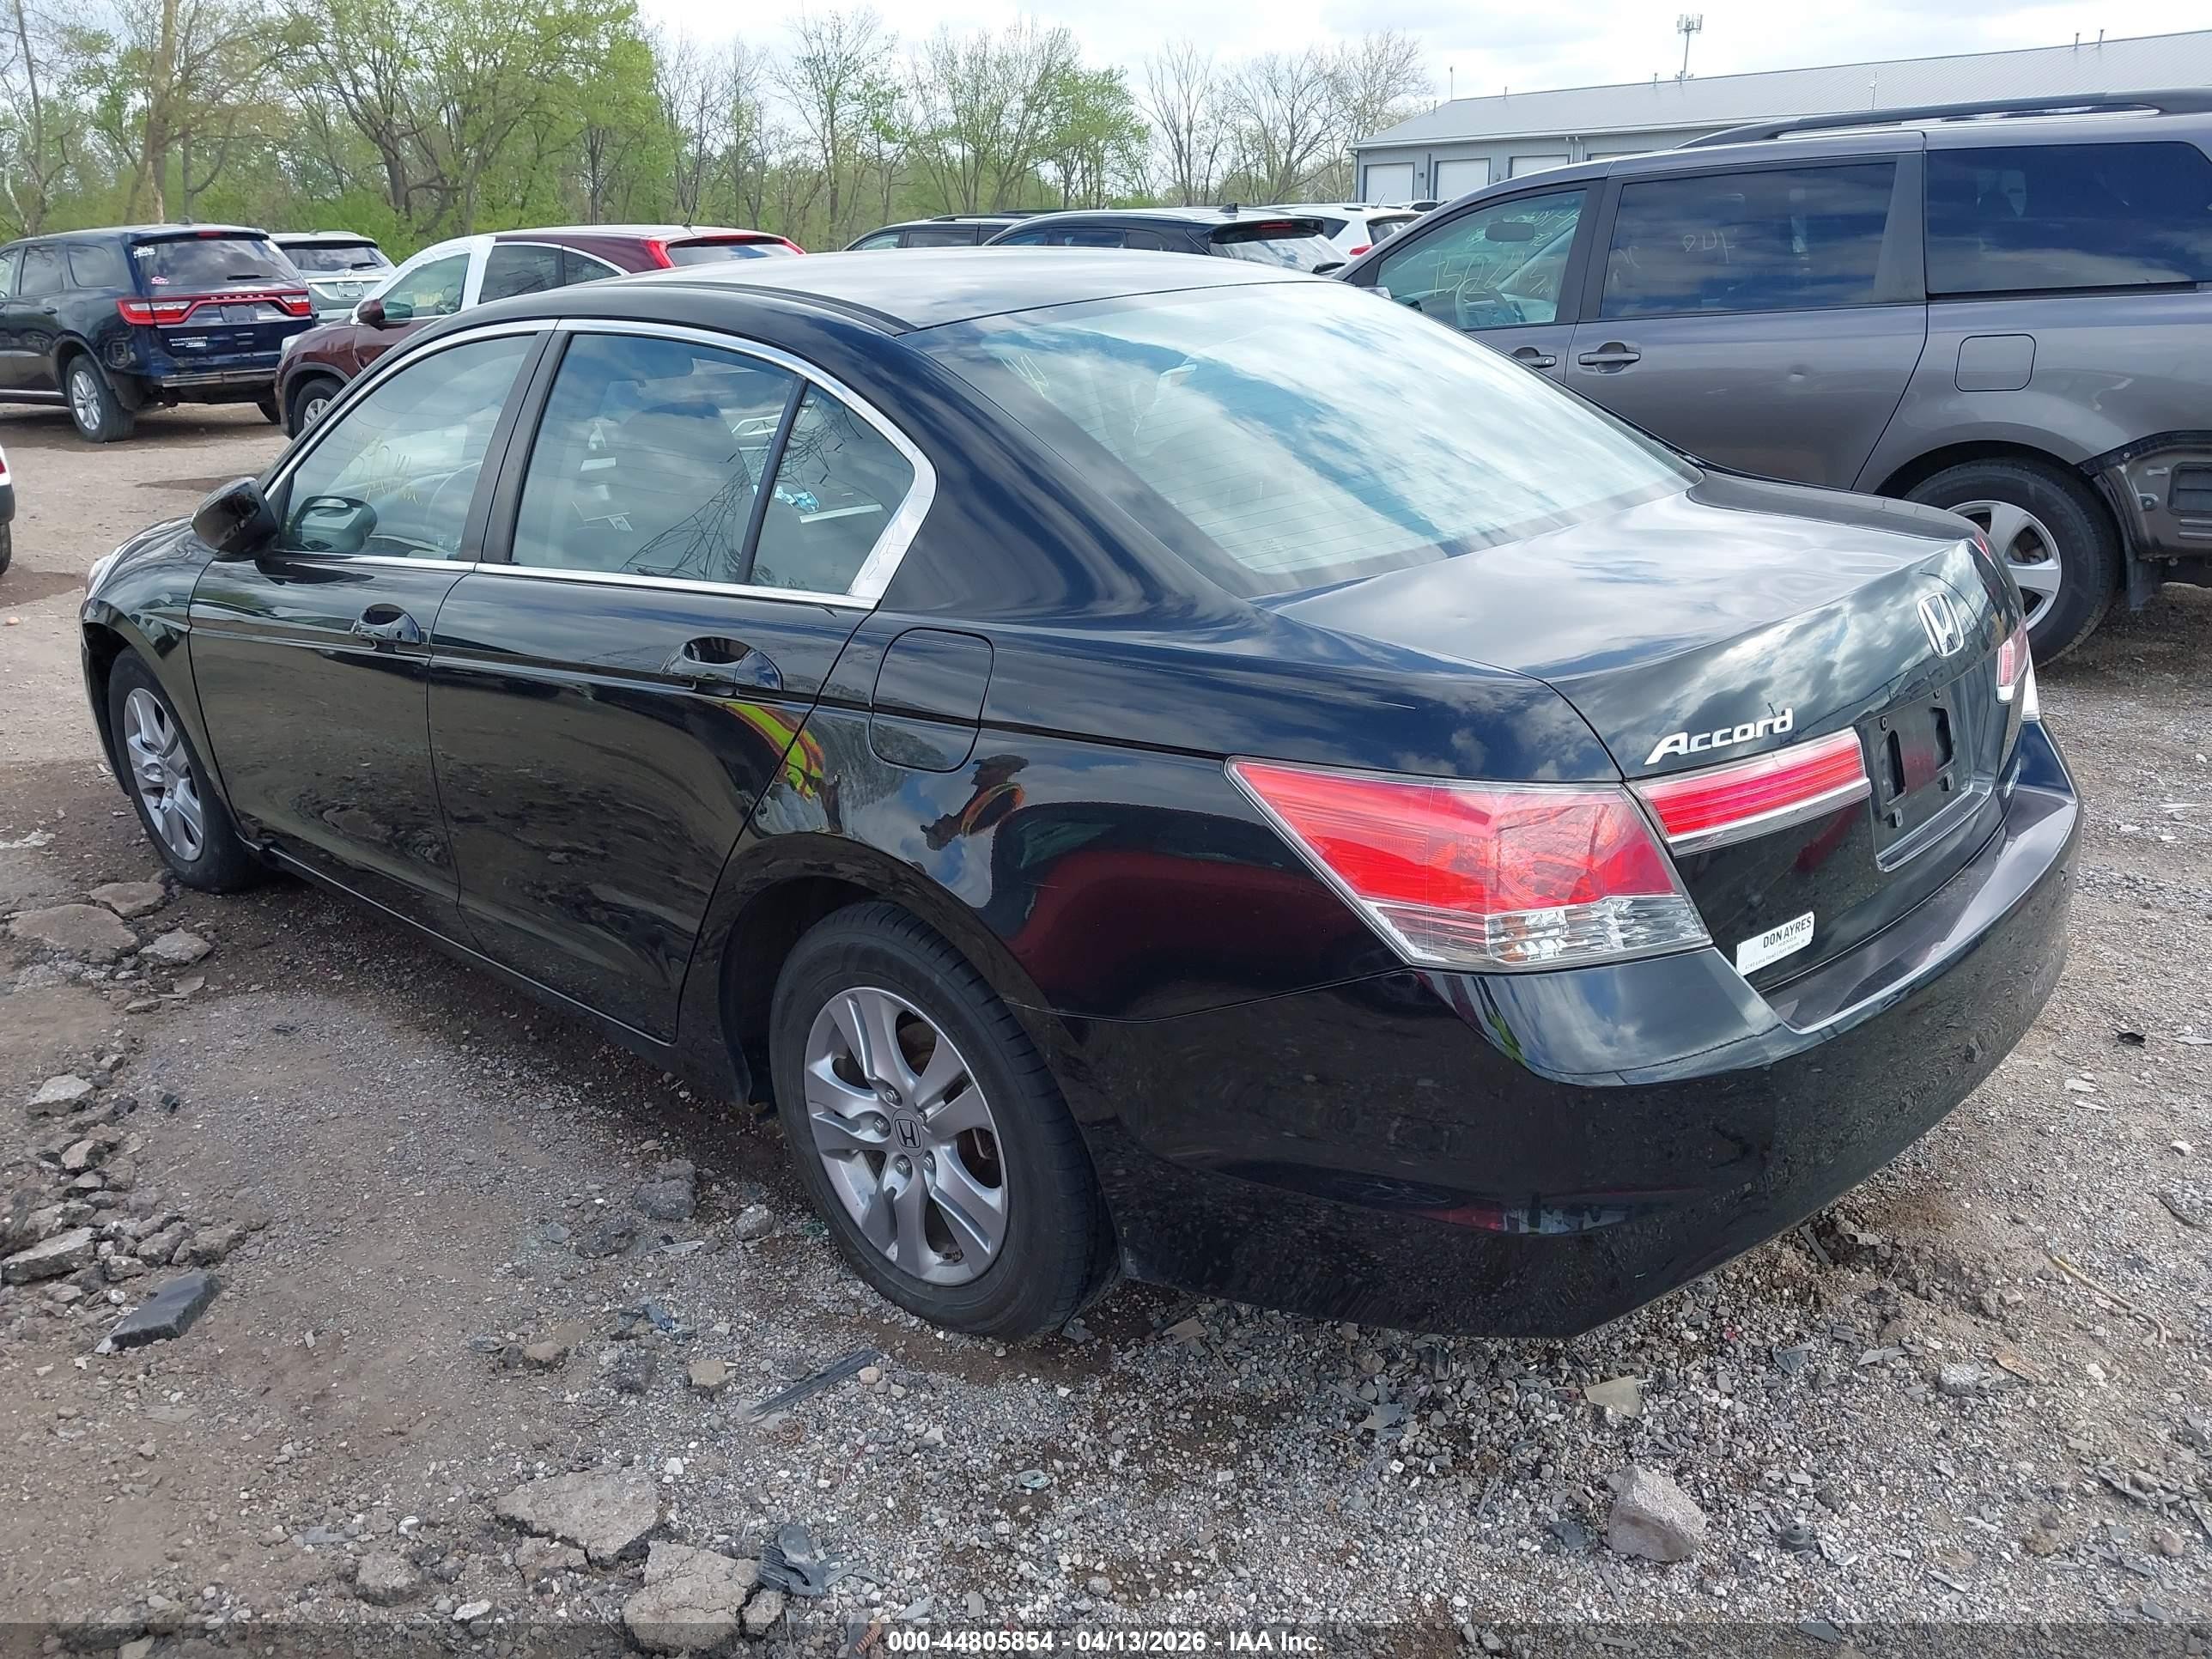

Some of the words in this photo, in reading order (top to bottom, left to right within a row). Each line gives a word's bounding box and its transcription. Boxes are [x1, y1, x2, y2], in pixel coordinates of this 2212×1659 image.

[1644, 708, 1793, 766] Accord
[1763, 929, 1783, 949] DON
[1784, 916, 1812, 939] AYRES
